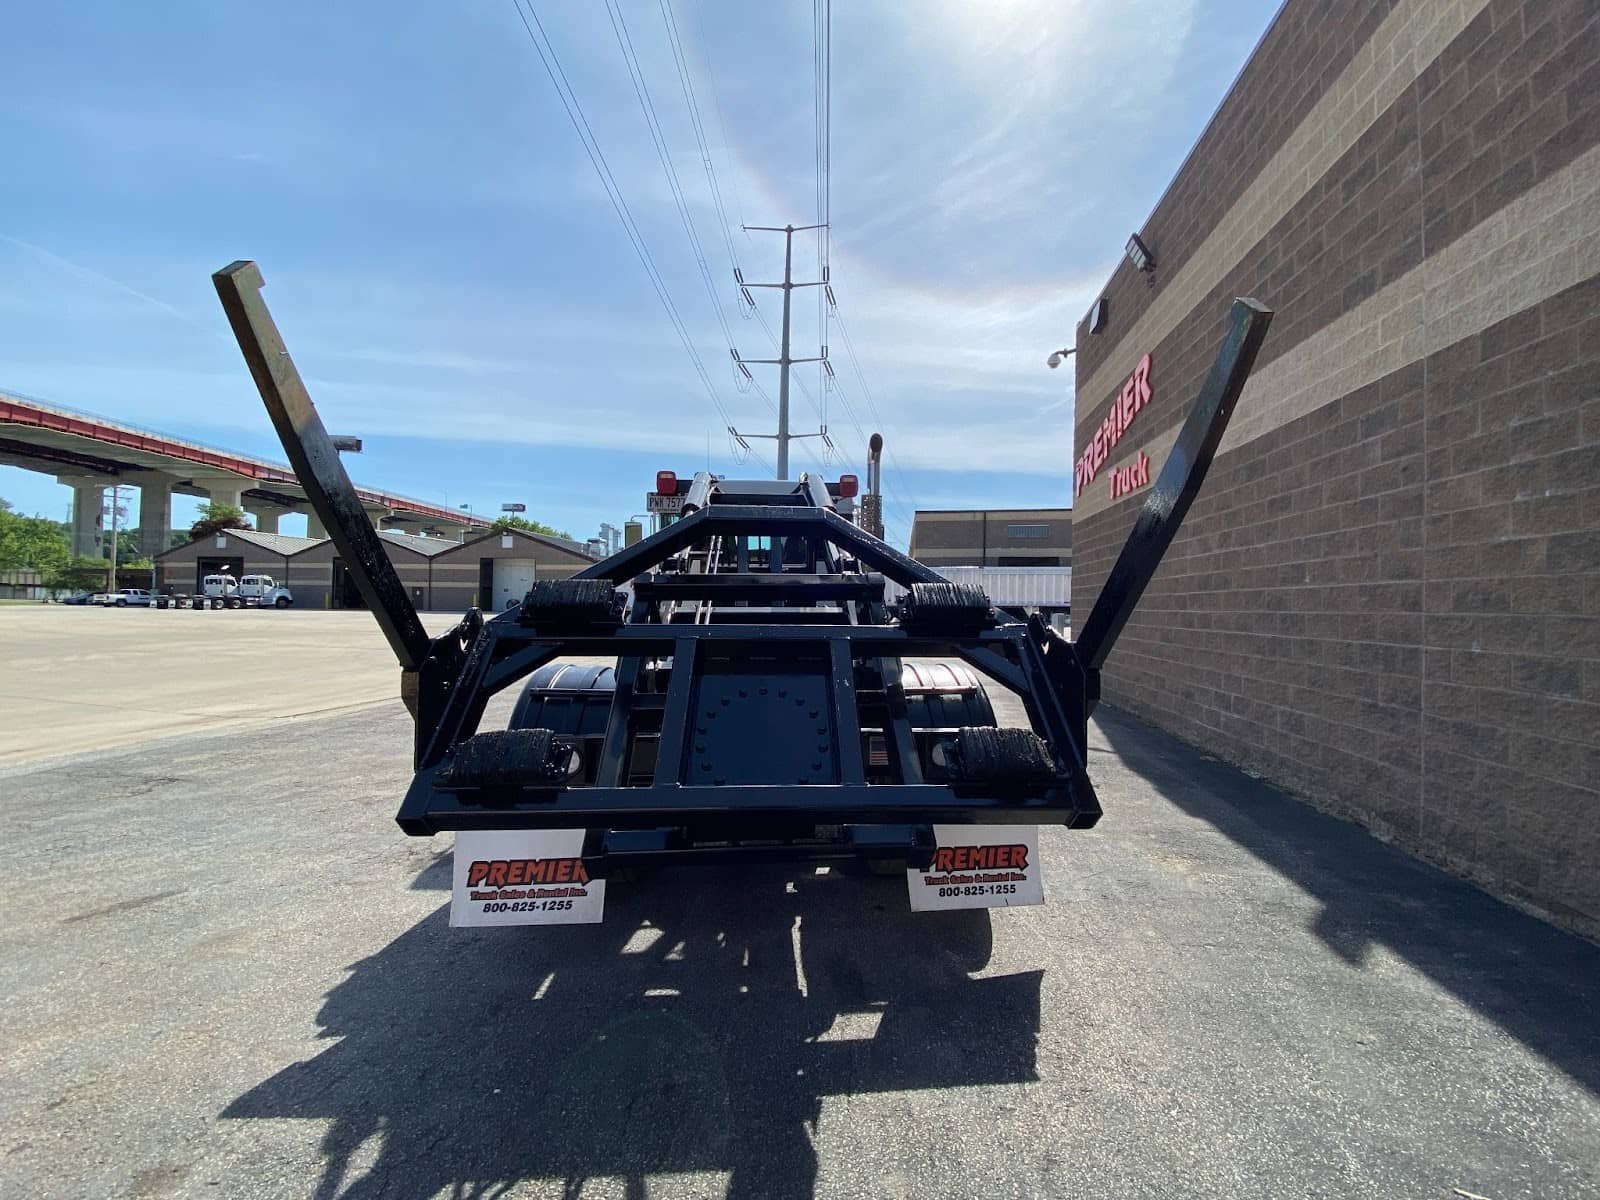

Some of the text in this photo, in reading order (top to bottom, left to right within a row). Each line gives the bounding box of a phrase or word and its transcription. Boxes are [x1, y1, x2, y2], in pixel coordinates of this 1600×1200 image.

[1075, 352, 1153, 498] PREMIER
[1108, 451, 1150, 500] Truck
[930, 844, 1029, 874] REMIER
[974, 873, 982, 883] &
[470, 890, 498, 901] Truck
[500, 889, 526, 900] Sales
[526, 888, 536, 899] &
[536, 887, 569, 899] Rental
[938, 884, 1016, 897] 800-825-1255
[482, 900, 573, 913] 800-825-1255
